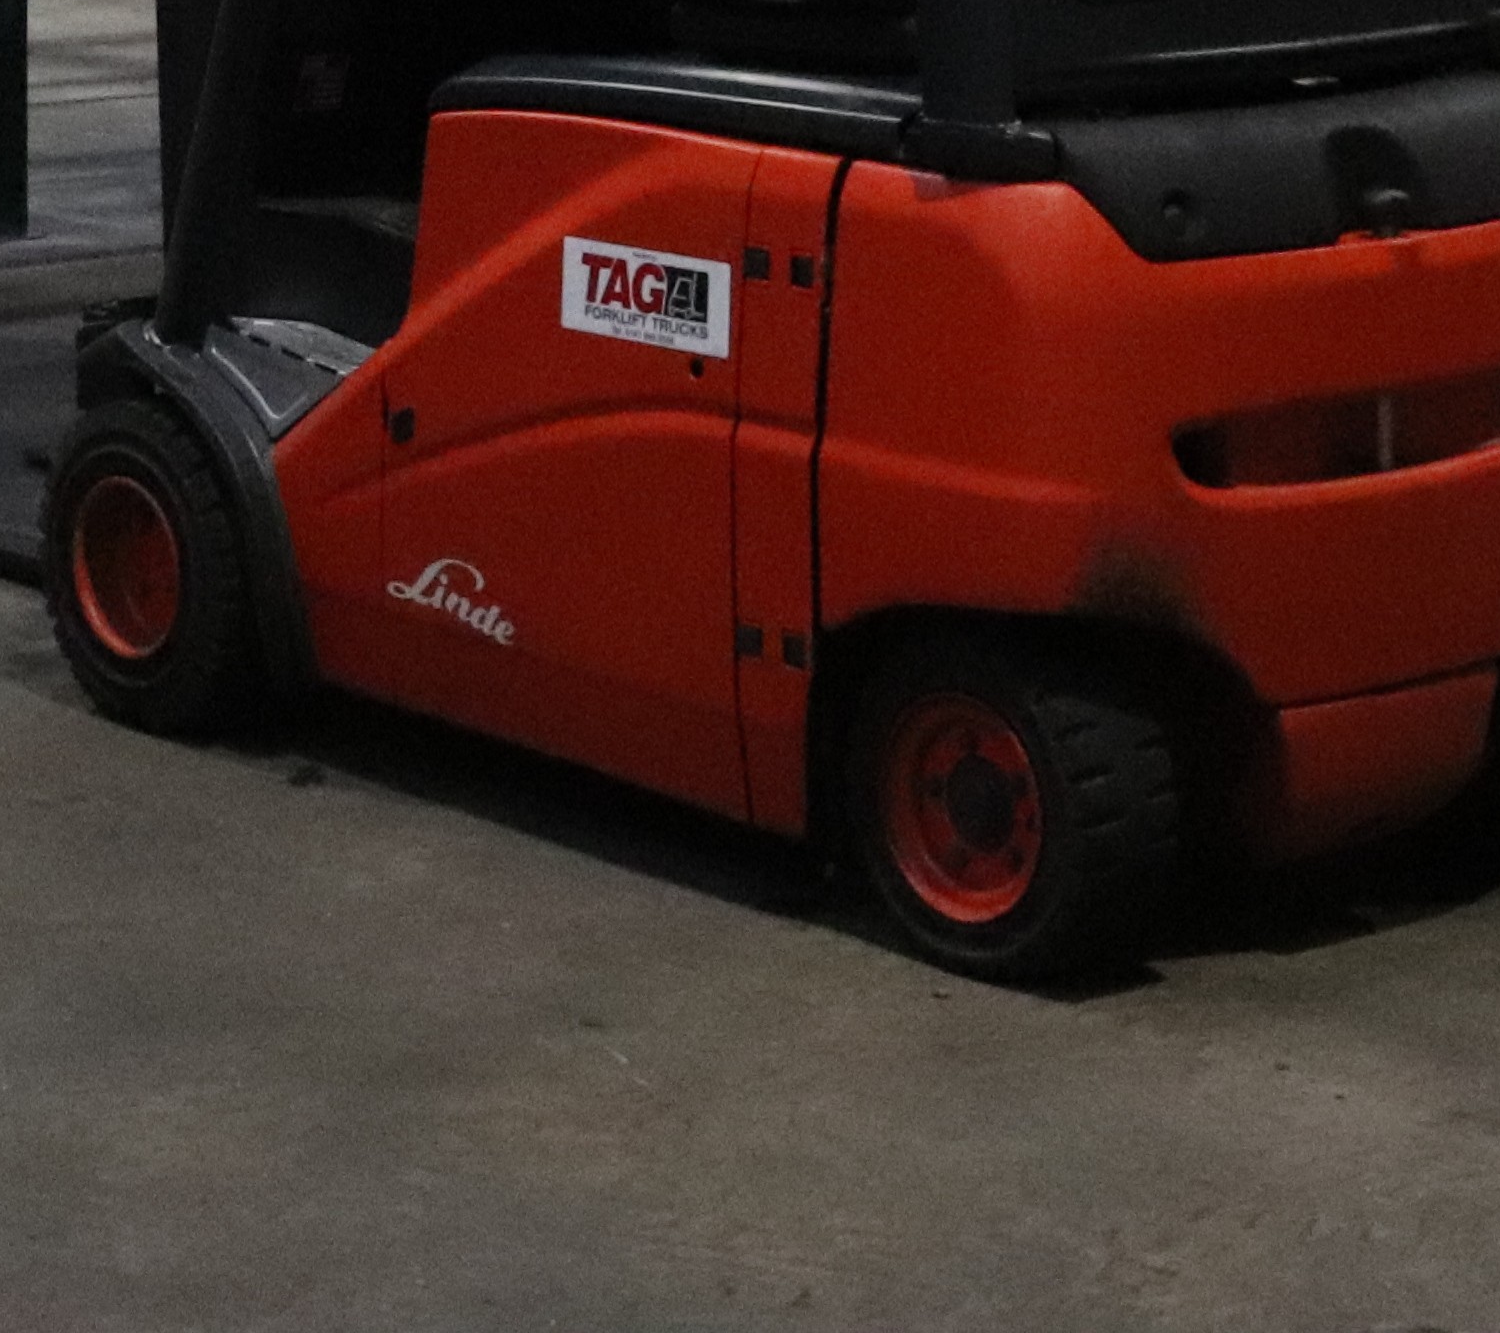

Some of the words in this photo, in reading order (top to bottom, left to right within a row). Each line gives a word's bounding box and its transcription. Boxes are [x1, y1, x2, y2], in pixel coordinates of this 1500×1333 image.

[582, 252, 667, 315] TAG
[584, 305, 648, 329] FORKLIFT
[651, 317, 709, 340] TRUCKS
[387, 558, 516, 647] Linde
